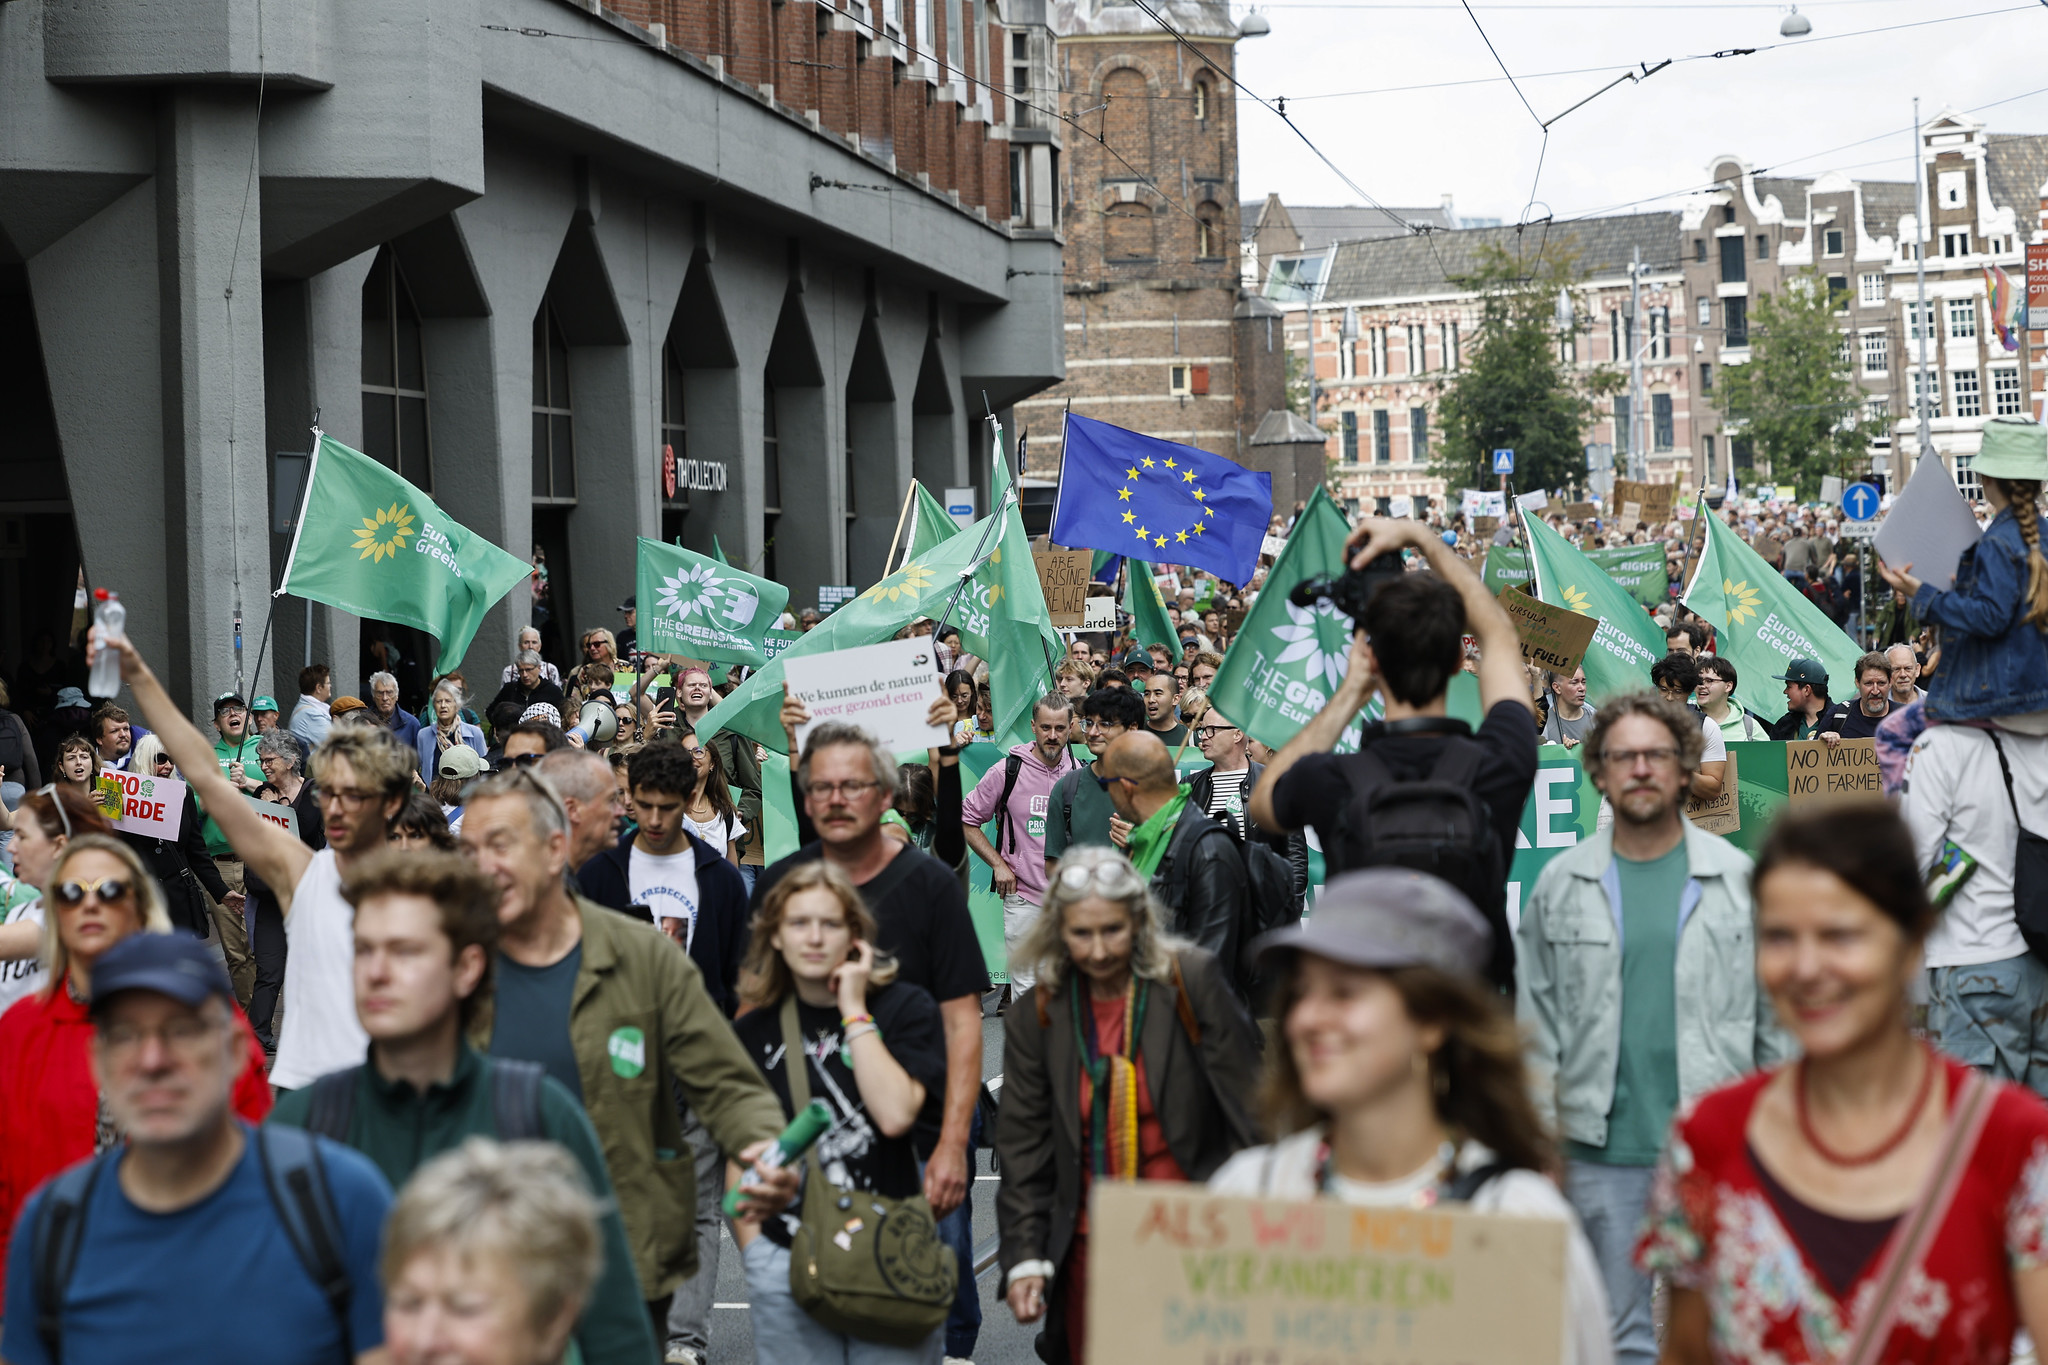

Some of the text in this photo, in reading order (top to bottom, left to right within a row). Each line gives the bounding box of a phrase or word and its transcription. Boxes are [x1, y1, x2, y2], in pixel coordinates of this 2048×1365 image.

[688, 459, 727, 492] COLLECTION
[416, 538, 461, 578] Greens
[1051, 556, 1075, 569] ARE
[1620, 560, 1662, 573] RIGHTS
[1046, 568, 1086, 586] RISING
[1509, 603, 1547, 625] URSULA
[1522, 619, 1544, 632] SAY
[675, 631, 712, 648] European
[1592, 629, 1637, 665] Greens
[1598, 615, 1656, 664] European
[1533, 647, 1569, 668] FUELS
[795, 672, 933, 703] We kunnen de natuur
[1243, 674, 1255, 693] in
[1253, 684, 1277, 709] the
[812, 690, 924, 717] weer gezond eten
[1790, 749, 1819, 770] NO
[1794, 775, 1819, 795] NO
[1028, 820, 1045, 828] PRO
